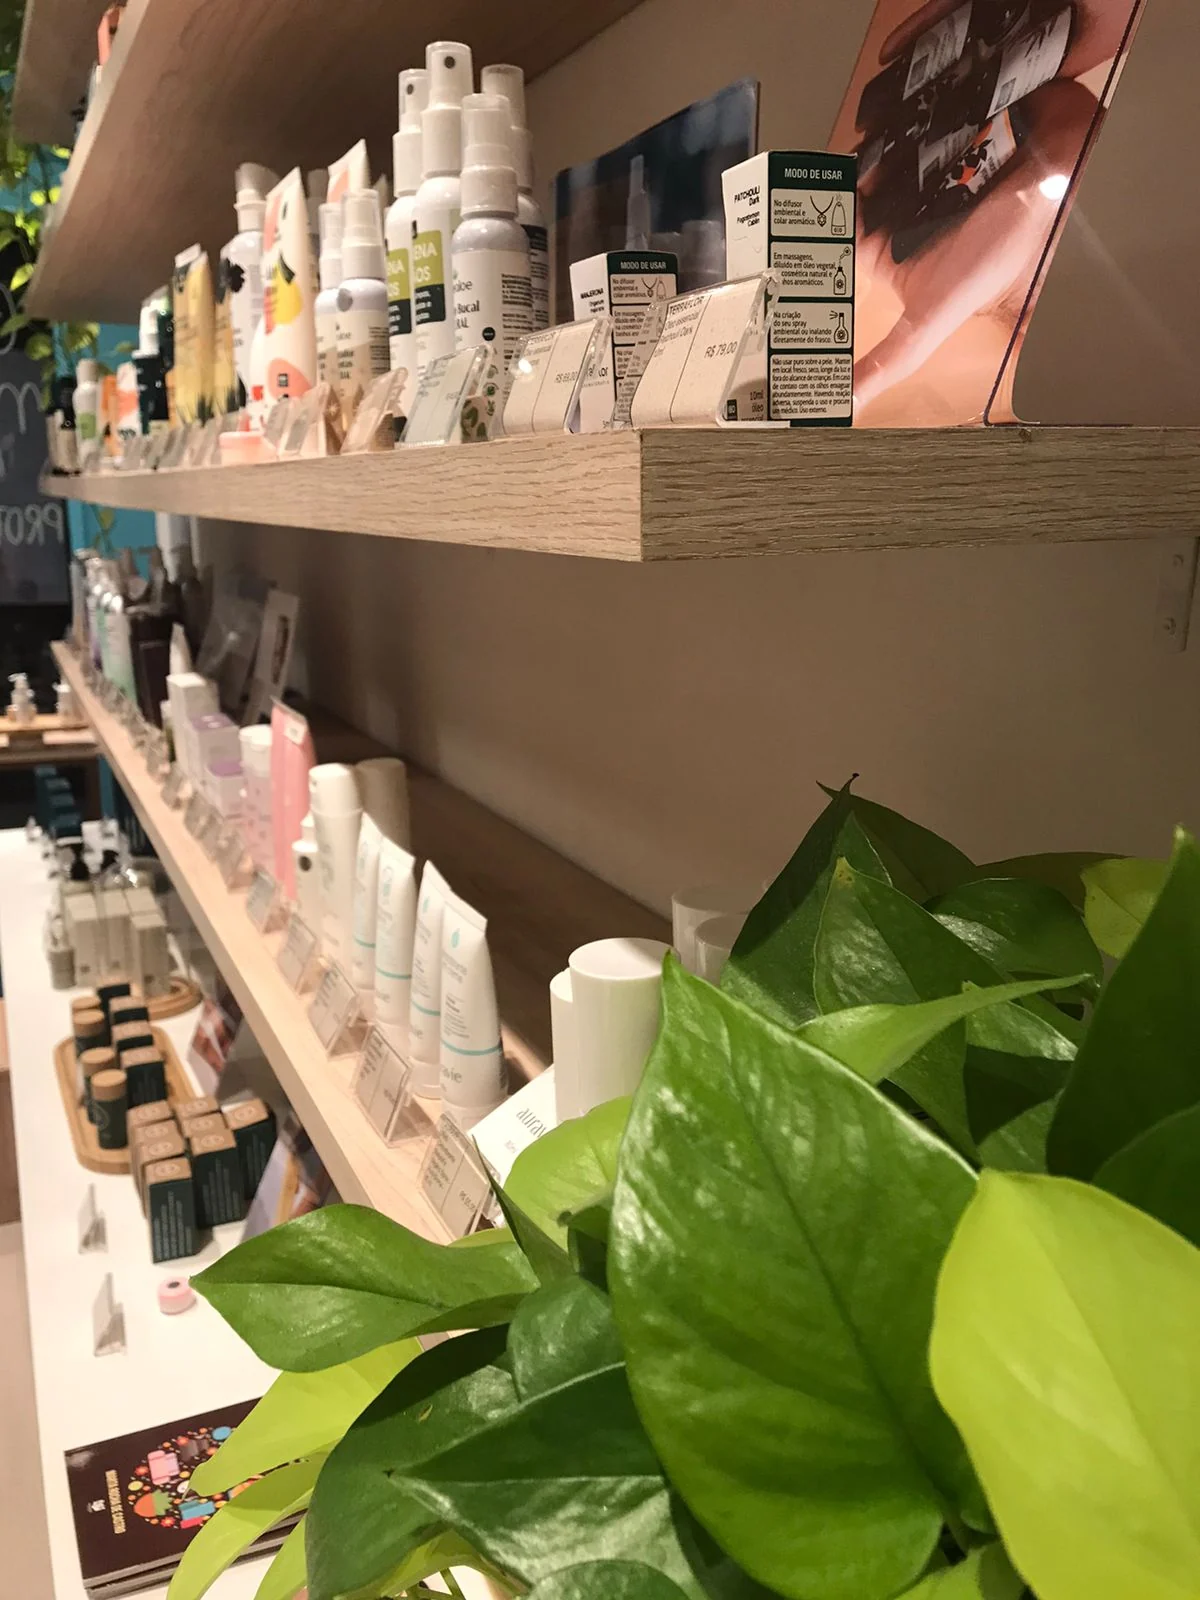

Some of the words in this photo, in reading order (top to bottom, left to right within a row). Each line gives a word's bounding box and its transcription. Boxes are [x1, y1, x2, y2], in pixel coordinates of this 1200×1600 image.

[784, 168, 808, 178] MODO
[810, 169, 820, 179] DE
[822, 170, 843, 180] USAR
[734, 185, 760, 204] PATCHOULI
[788, 217, 816, 225] aromático.
[773, 252, 782, 260] Em
[783, 254, 813, 262] massagens,
[621, 261, 639, 269] MODO
[641, 261, 649, 269] DE
[803, 261, 815, 269] óleo
[817, 262, 837, 270] vegetal,
[781, 311, 801, 320] criação
[704, 345, 716, 358] R$
[716, 341, 737, 356] 79,00
[793, 359, 804, 367] puro
[821, 366, 833, 374] longe
[793, 399, 814, 407] suspenda
